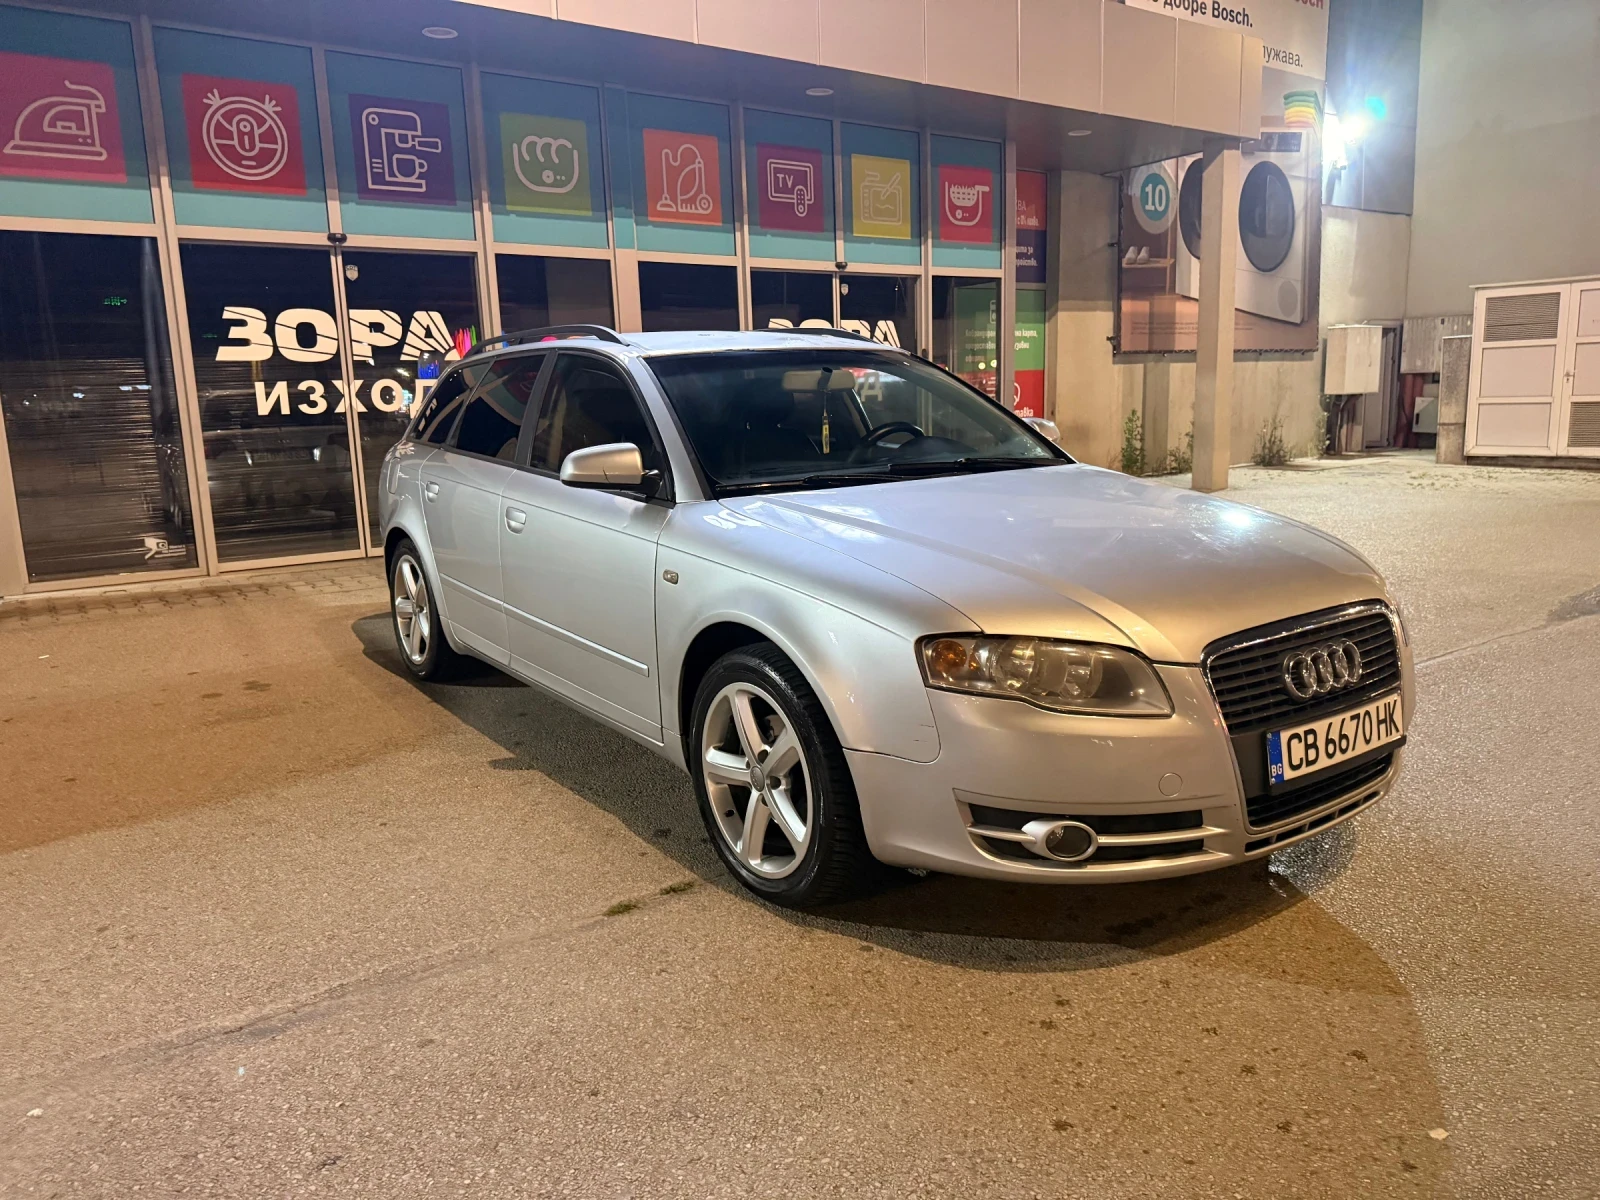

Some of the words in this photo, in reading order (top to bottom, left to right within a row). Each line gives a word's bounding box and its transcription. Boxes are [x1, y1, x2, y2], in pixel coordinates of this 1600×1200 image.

[1211, 3, 1253, 28] Bosch.
[776, 172, 794, 189] TV
[1144, 183, 1167, 212] 10
[215, 306, 463, 362] ЗОРА
[1287, 728, 1320, 771] CB
[1324, 709, 1373, 760] 6670
[1376, 699, 1400, 741] HK
[1271, 763, 1283, 776] BG
